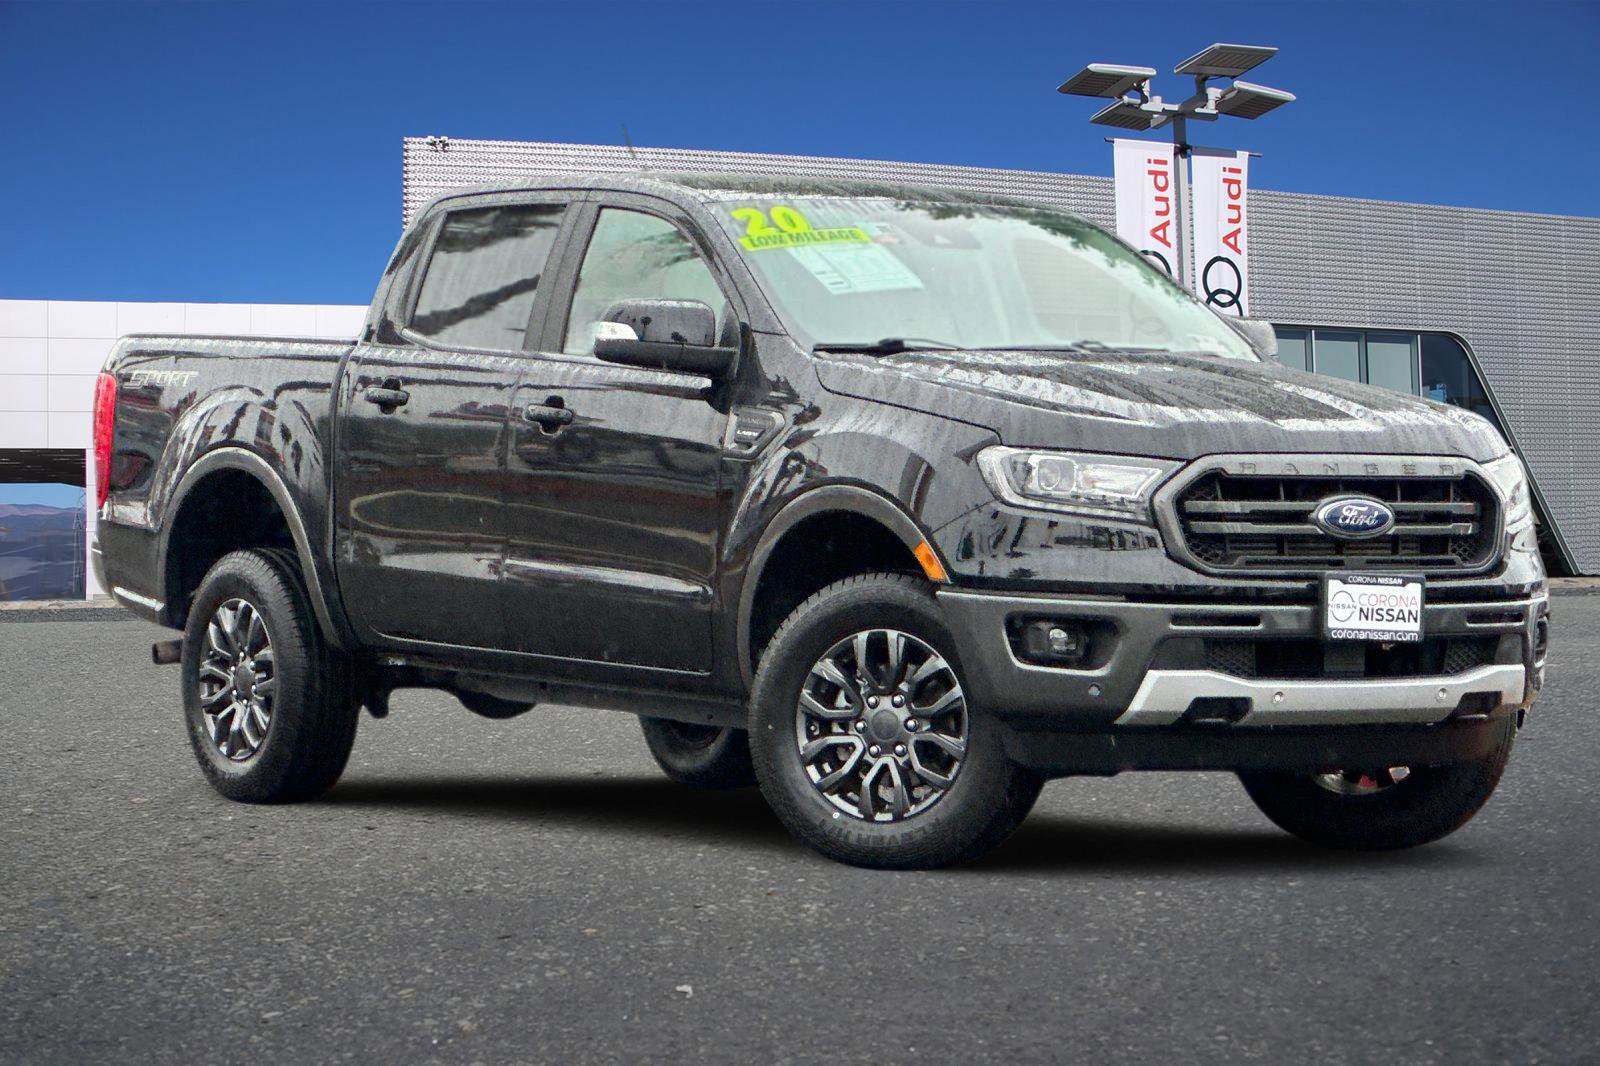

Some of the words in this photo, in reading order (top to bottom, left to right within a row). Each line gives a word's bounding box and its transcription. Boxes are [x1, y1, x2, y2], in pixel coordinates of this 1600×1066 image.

[1147, 158, 1171, 248] Audi
[1222, 166, 1242, 256] Audi
[731, 206, 810, 235] 20
[750, 231, 784, 248] LOW
[788, 227, 862, 244] MILEAGE
[123, 369, 199, 389] SPORT
[1339, 505, 1379, 525] Ford
[1347, 575, 1376, 583] CORONA
[1358, 593, 1418, 608] CORONA
[1358, 607, 1418, 622] NISSAN
